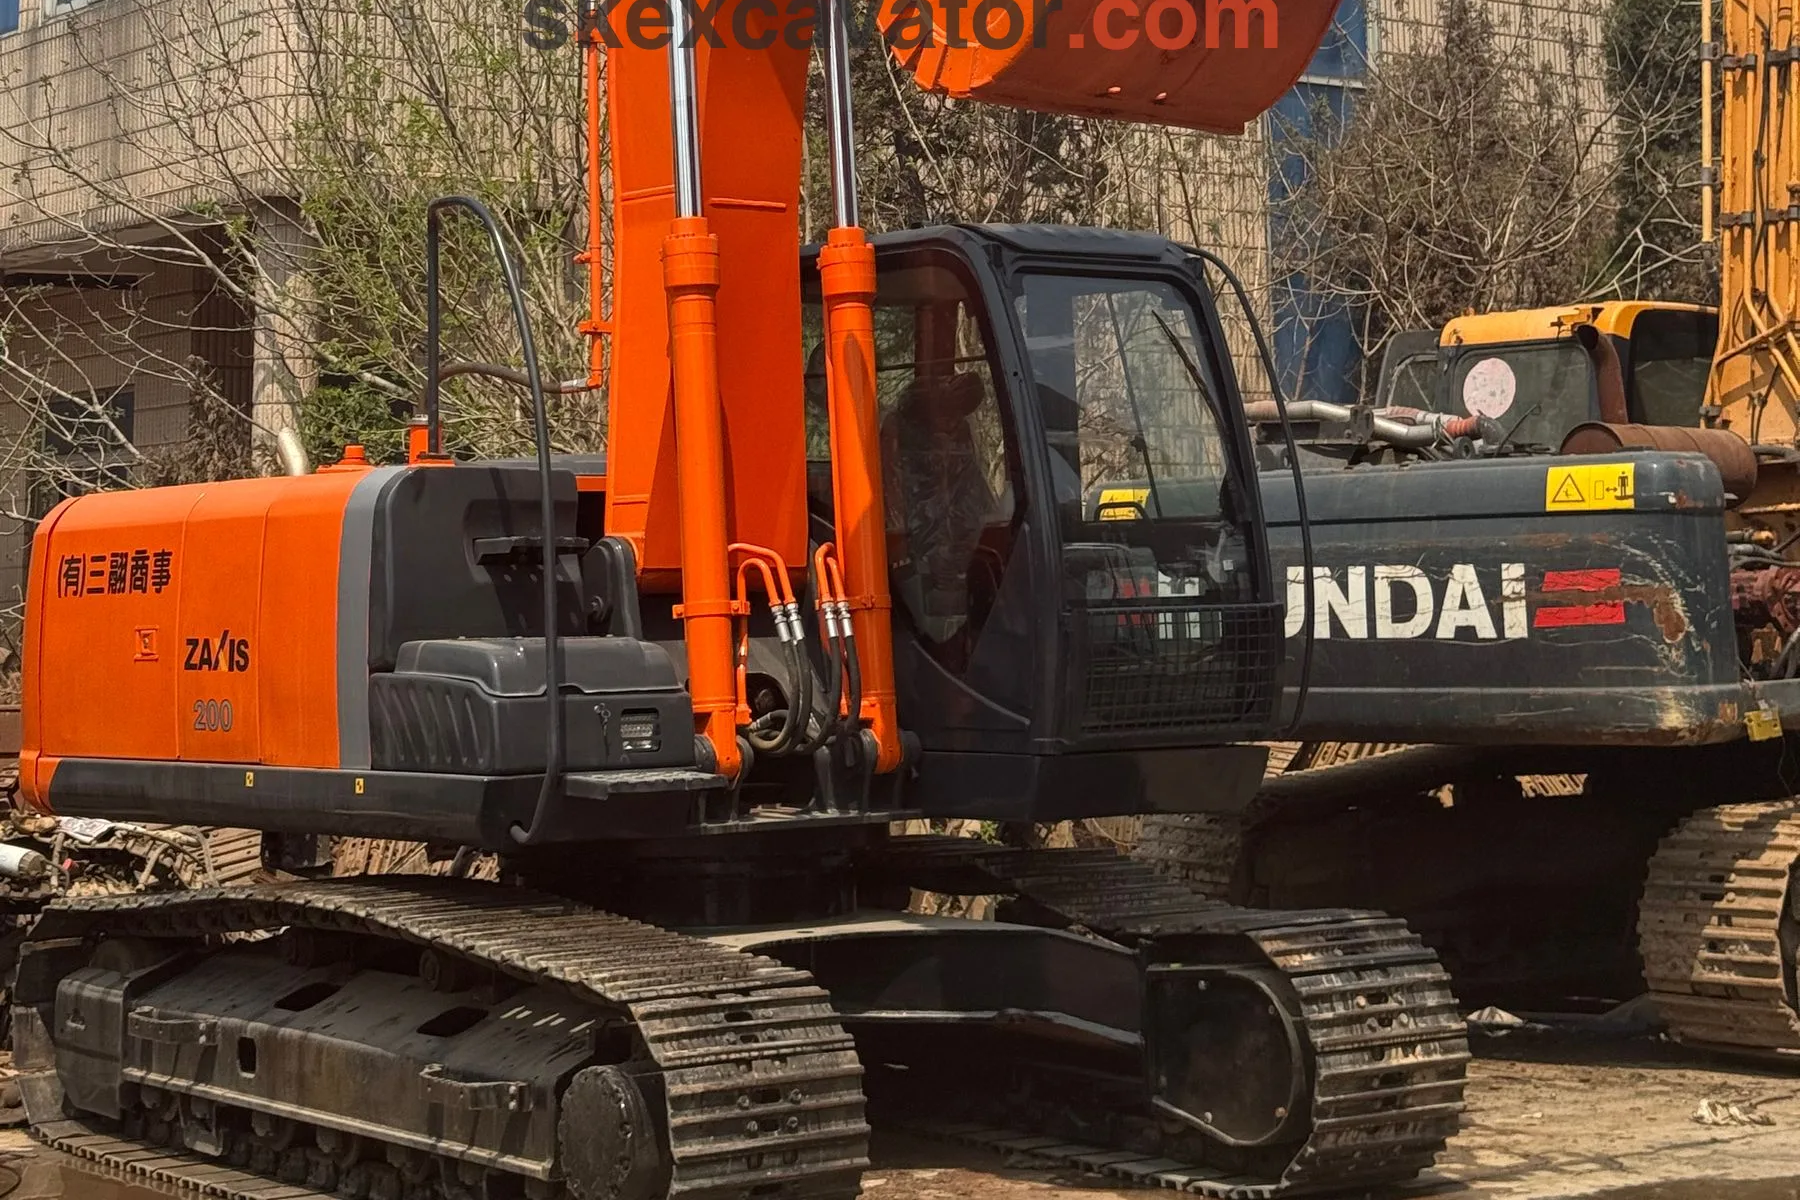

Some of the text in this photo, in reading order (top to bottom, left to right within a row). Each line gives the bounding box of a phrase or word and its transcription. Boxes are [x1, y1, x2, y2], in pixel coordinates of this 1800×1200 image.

[1158, 562, 1528, 639] HNDAI
[184, 629, 249, 672] ZAXIS
[193, 698, 233, 732] 200
